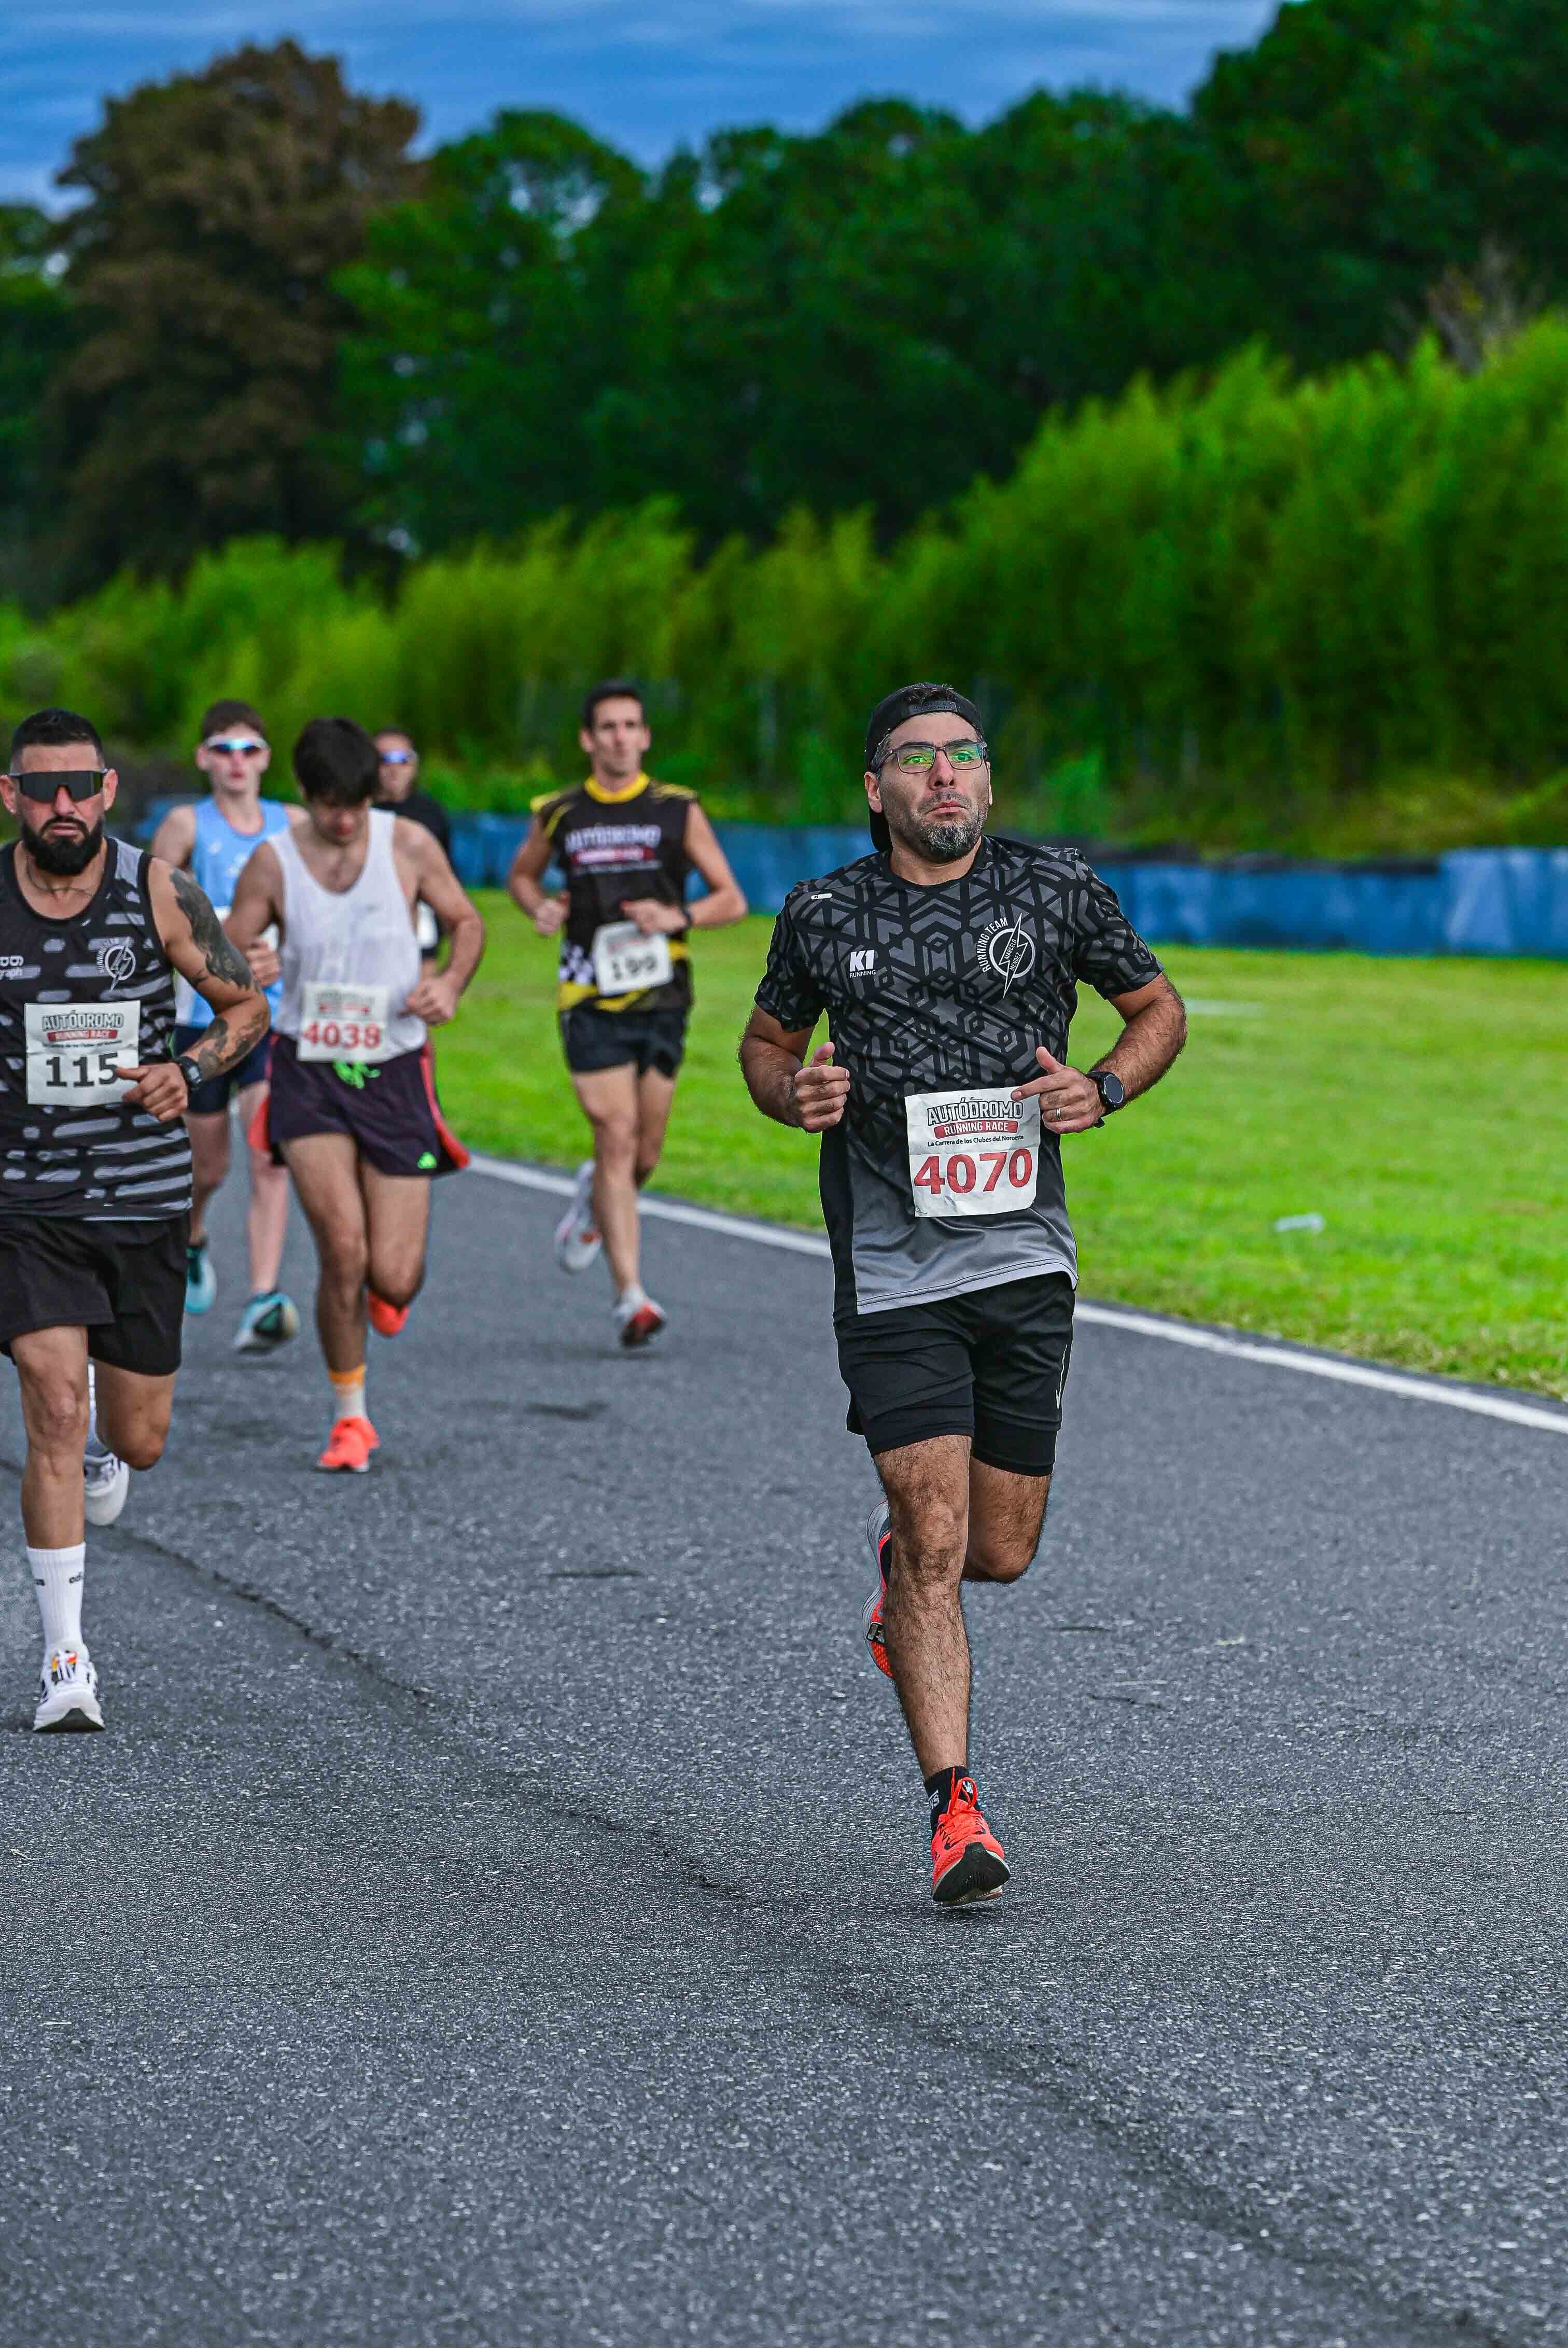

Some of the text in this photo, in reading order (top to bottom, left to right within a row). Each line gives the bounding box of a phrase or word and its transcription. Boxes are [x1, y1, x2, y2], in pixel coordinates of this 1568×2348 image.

[977, 917, 1009, 973] RUNNING TEAM
[1004, 939, 1017, 960] MARCELO
[849, 949, 875, 972] K1
[1009, 952, 1021, 971] MENDEZ
[849, 970, 876, 979] RUNNING
[41, 1010, 124, 1032] AUTÓDROMO
[302, 1020, 382, 1050] 4038
[46, 1052, 118, 1087] 115
[927, 1097, 1024, 1126] AUTÓDROMO
[944, 1121, 1009, 1136] RUNNING RACE
[914, 1148, 1032, 1194] 4070
